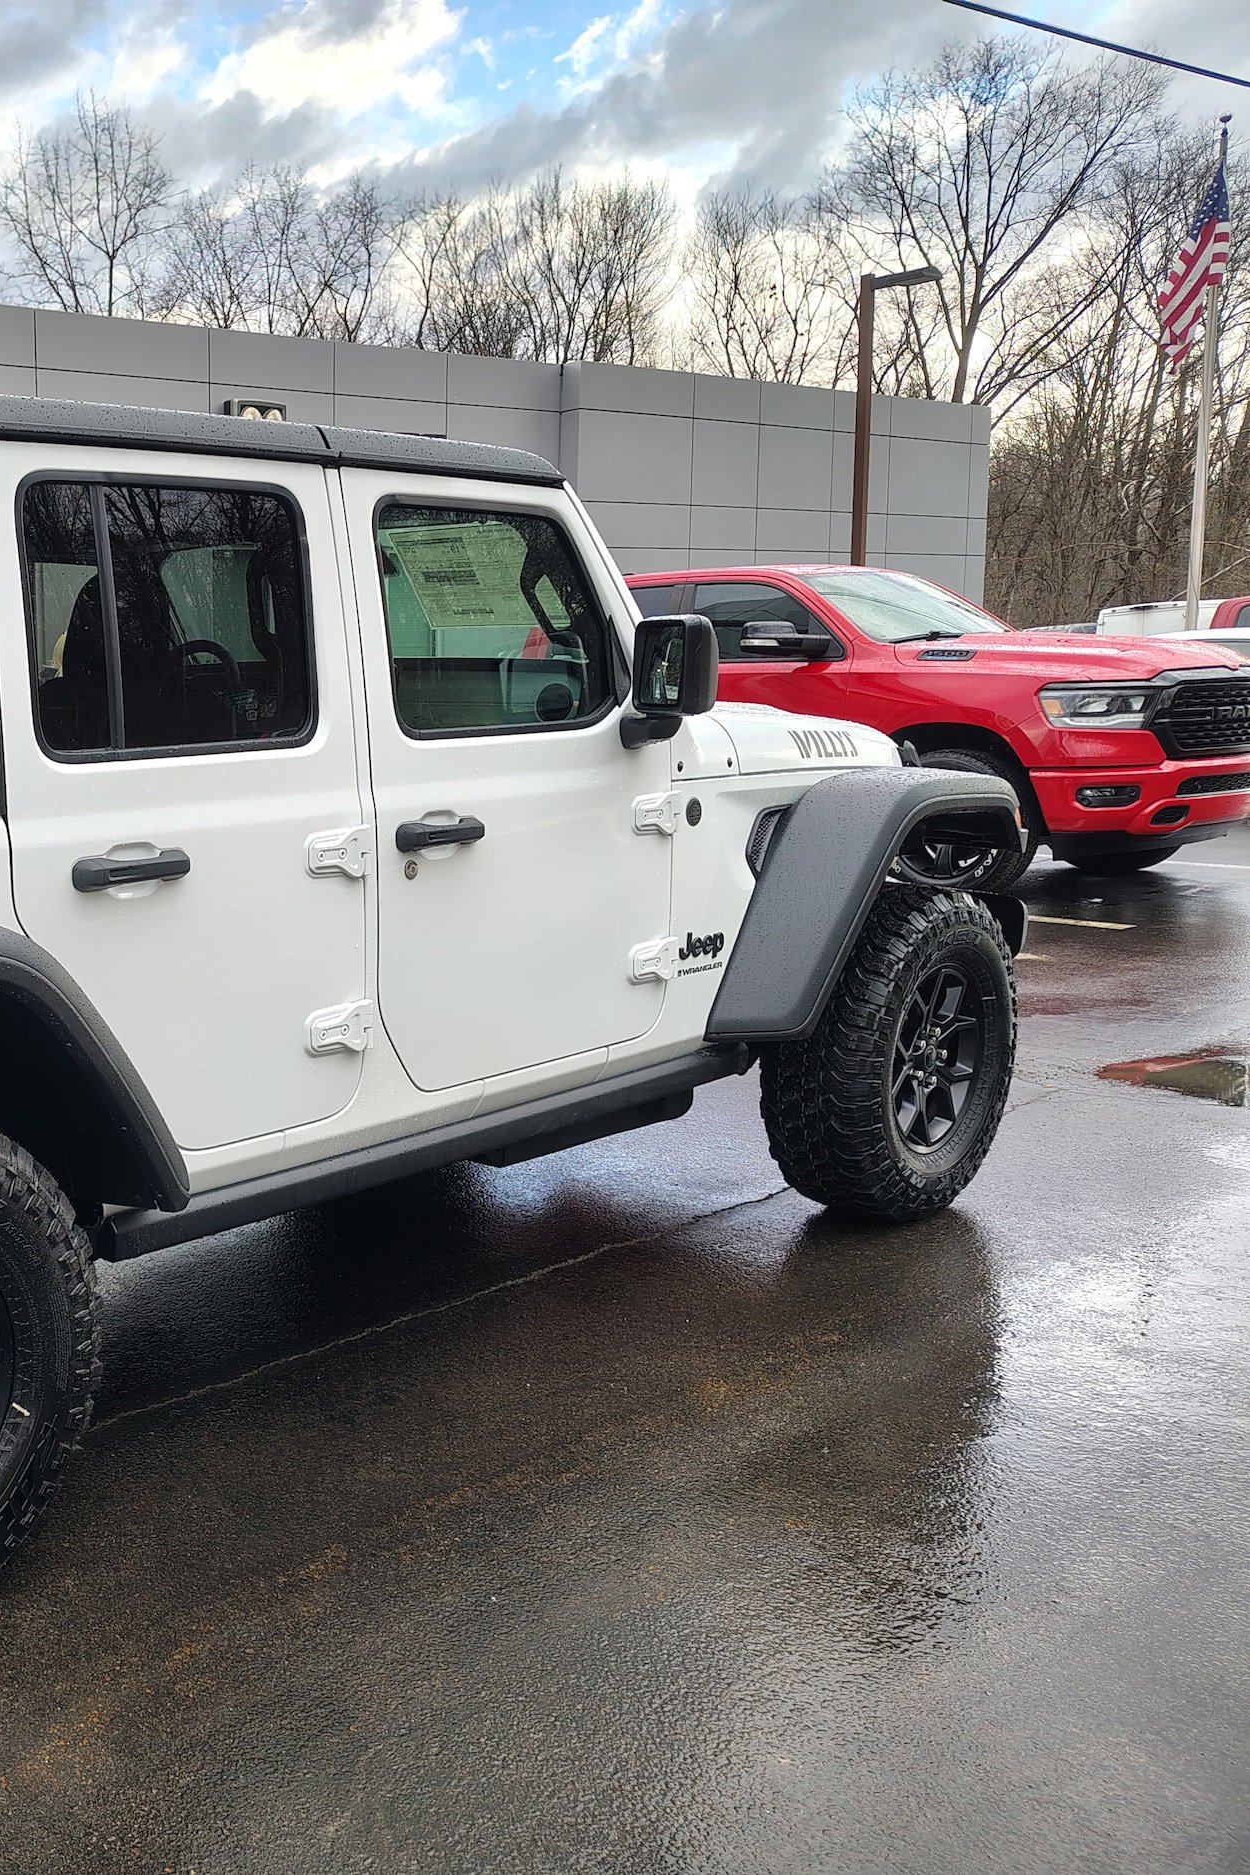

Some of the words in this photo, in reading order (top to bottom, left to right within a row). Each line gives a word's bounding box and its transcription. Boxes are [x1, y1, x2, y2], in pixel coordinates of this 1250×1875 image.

[787, 730, 858, 759] WILLYS
[679, 931, 724, 960] Jeep
[682, 961, 723, 976] WRANGLER
